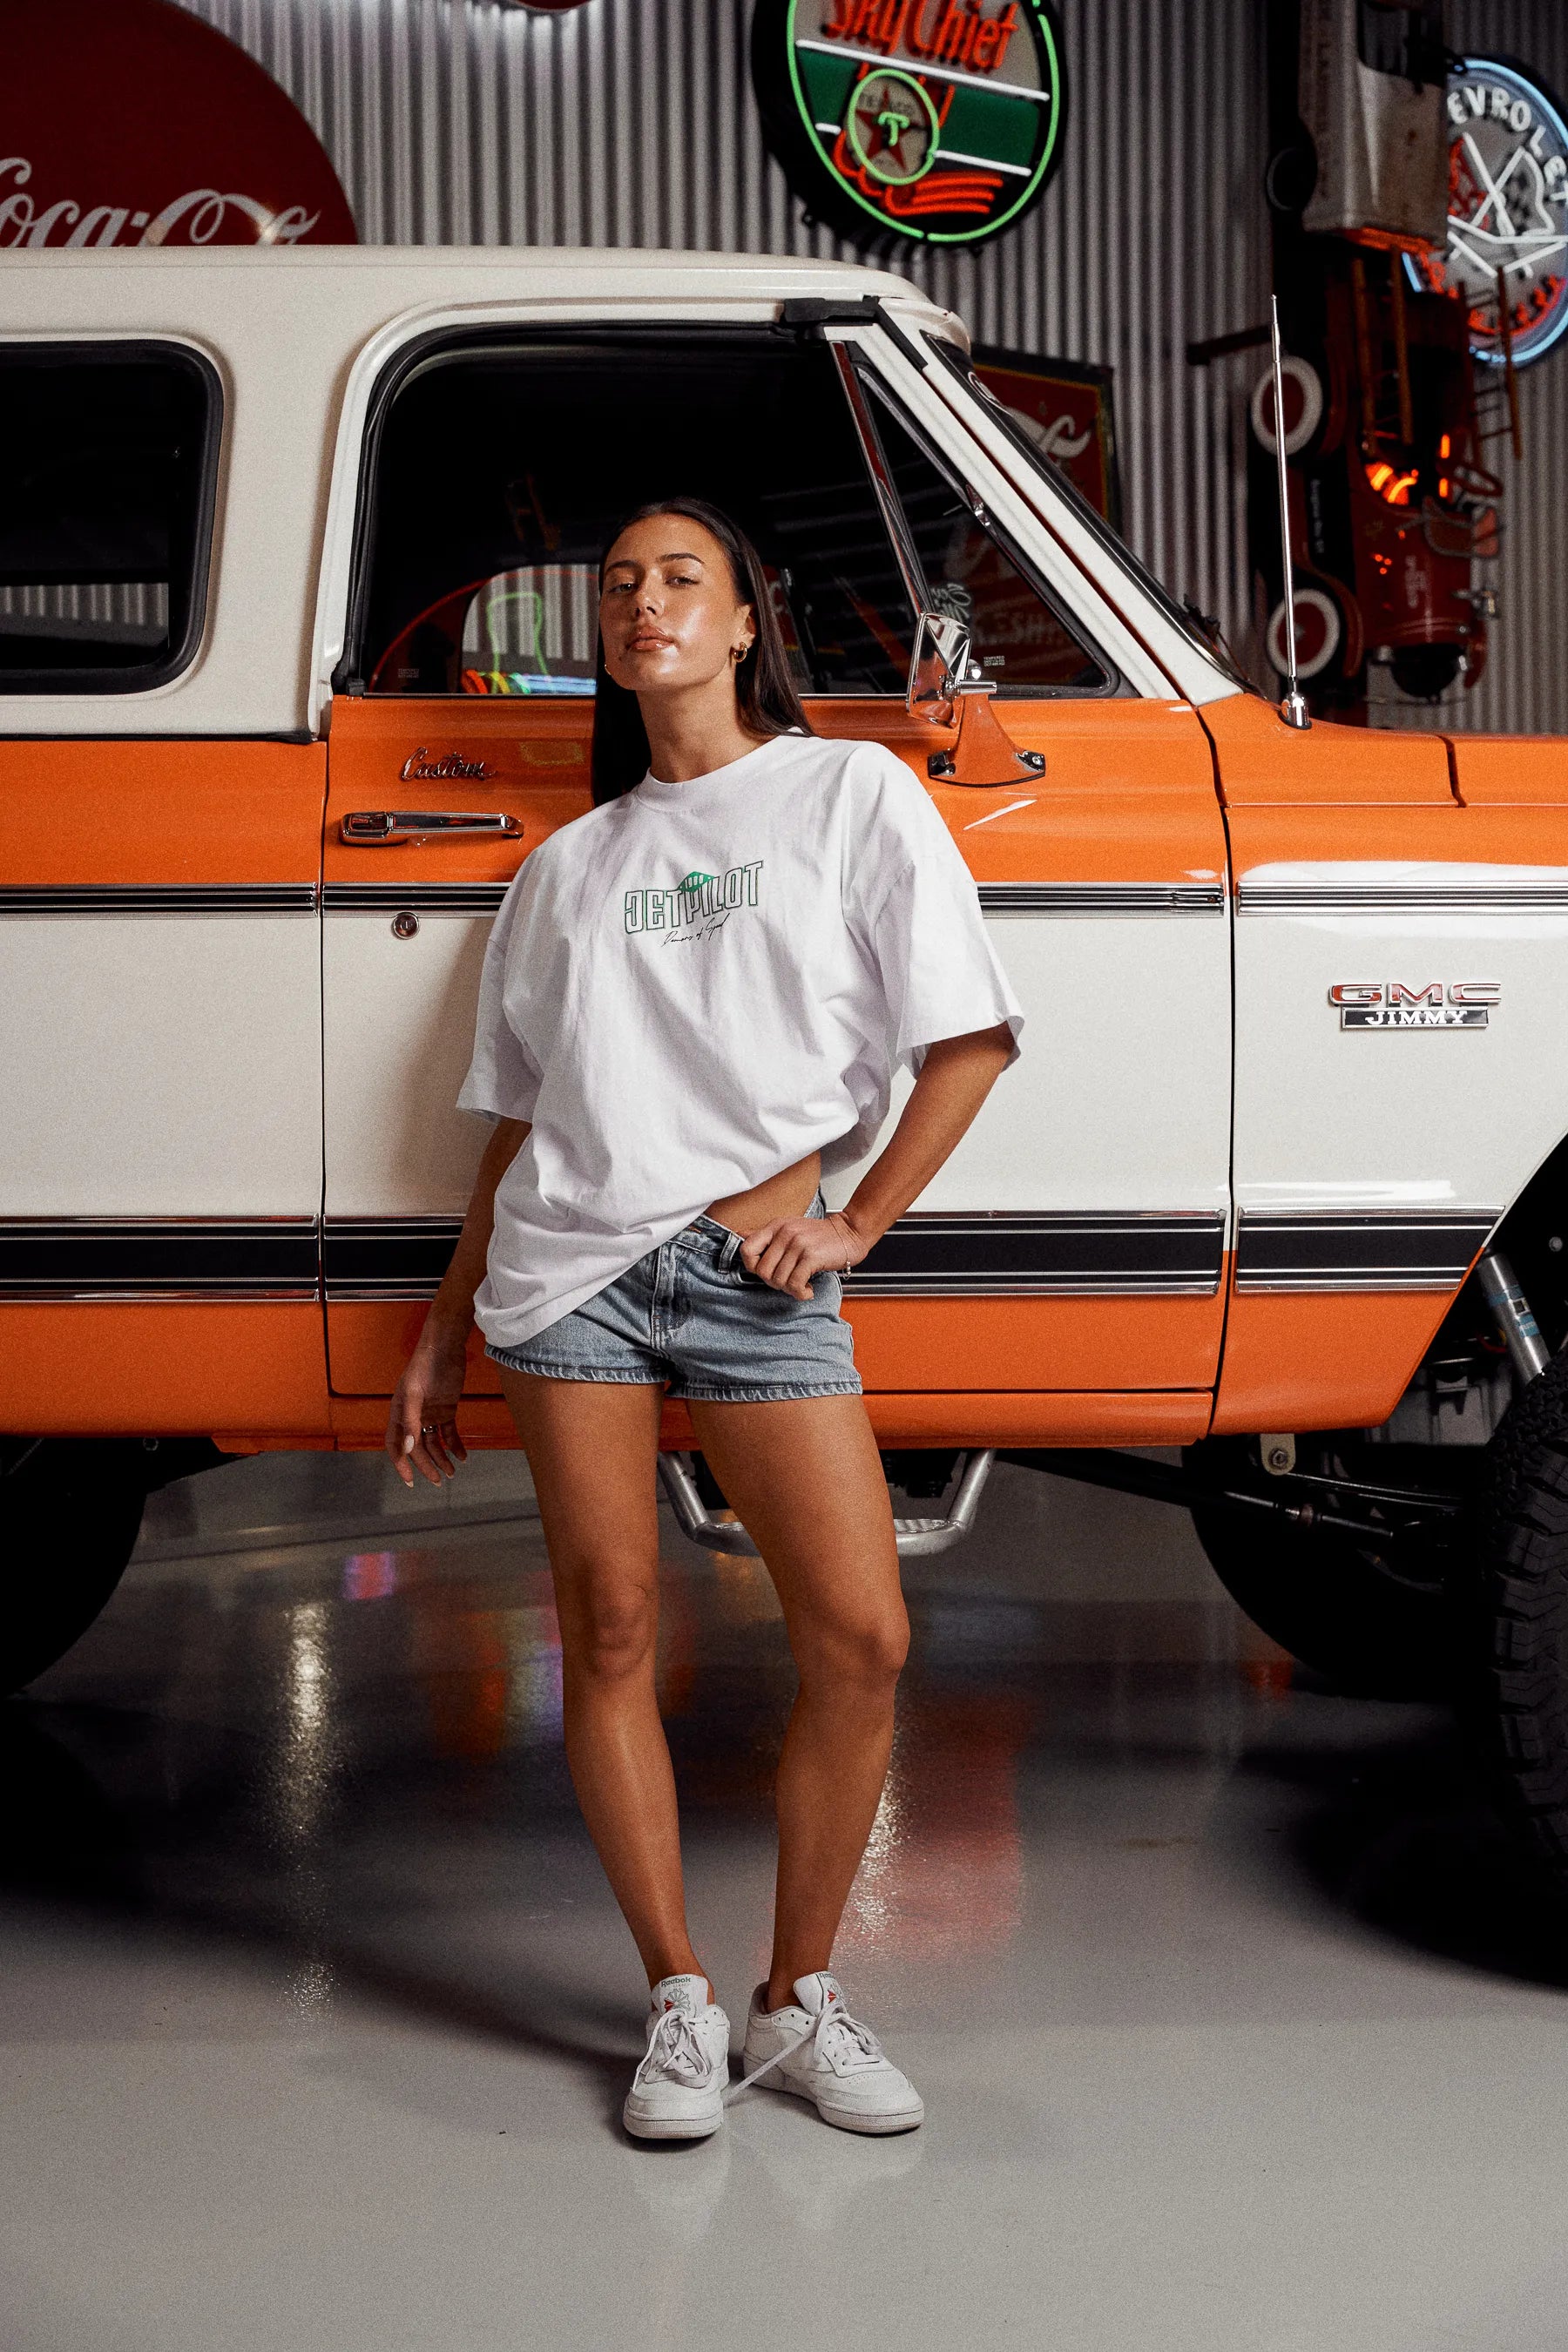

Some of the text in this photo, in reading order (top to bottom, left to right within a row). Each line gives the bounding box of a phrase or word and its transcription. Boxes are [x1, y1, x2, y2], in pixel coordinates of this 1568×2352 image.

[908, 0, 1018, 73] Chief
[1447, 85, 1568, 202] EVROLET
[400, 747, 498, 781] Custom
[625, 860, 764, 935] JETPILOT
[1328, 982, 1502, 1004] GMC
[1365, 1010, 1468, 1025] JIMMY
[661, 1977, 691, 1988] Reebok
